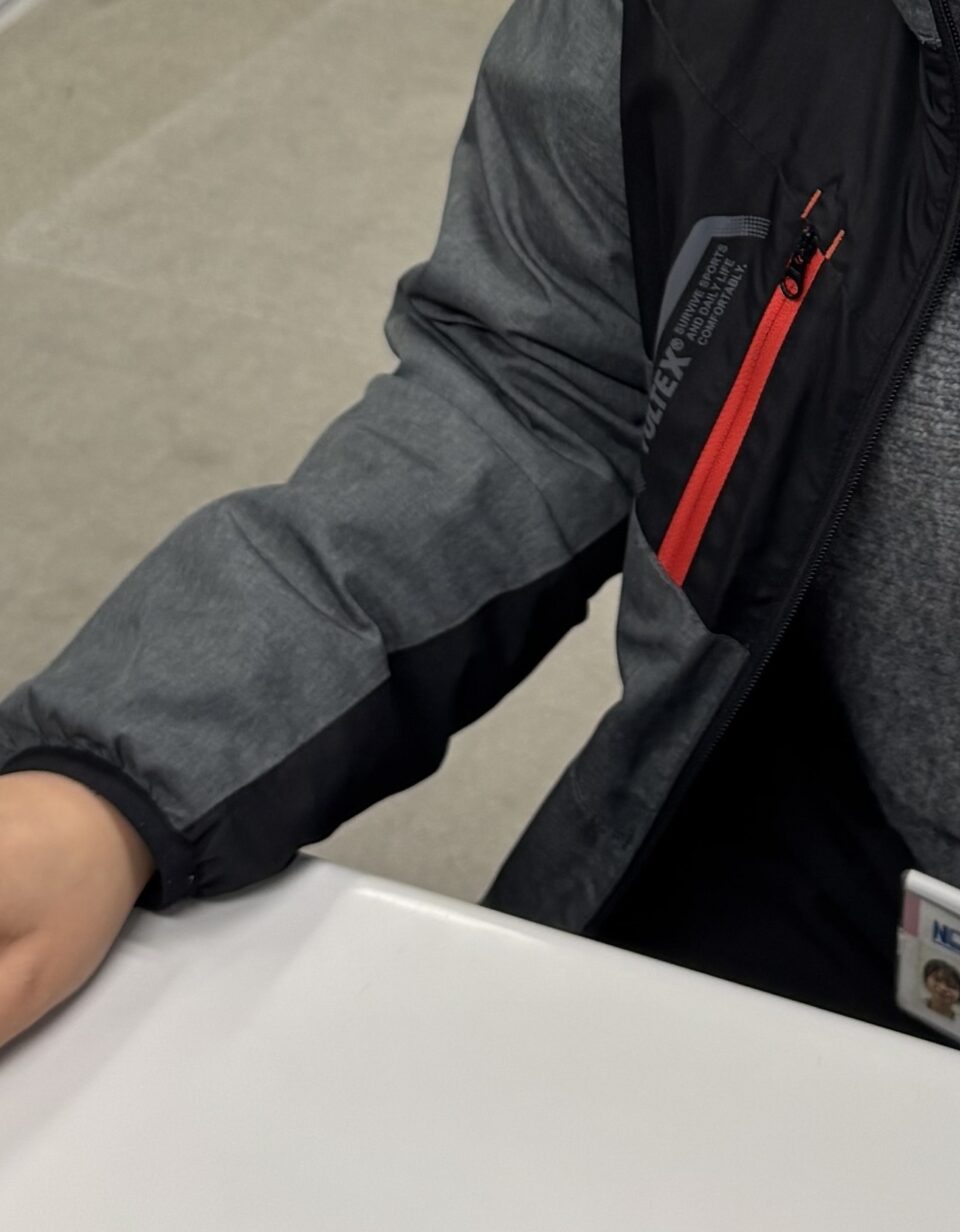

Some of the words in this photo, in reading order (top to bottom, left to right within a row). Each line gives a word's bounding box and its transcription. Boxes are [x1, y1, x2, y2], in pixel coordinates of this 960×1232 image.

[675, 288, 704, 336] SURVIVE
[699, 244, 729, 286] SPORTS
[686, 313, 705, 342] AND
[699, 280, 722, 319] DAILY
[716, 257, 736, 285] LIFE
